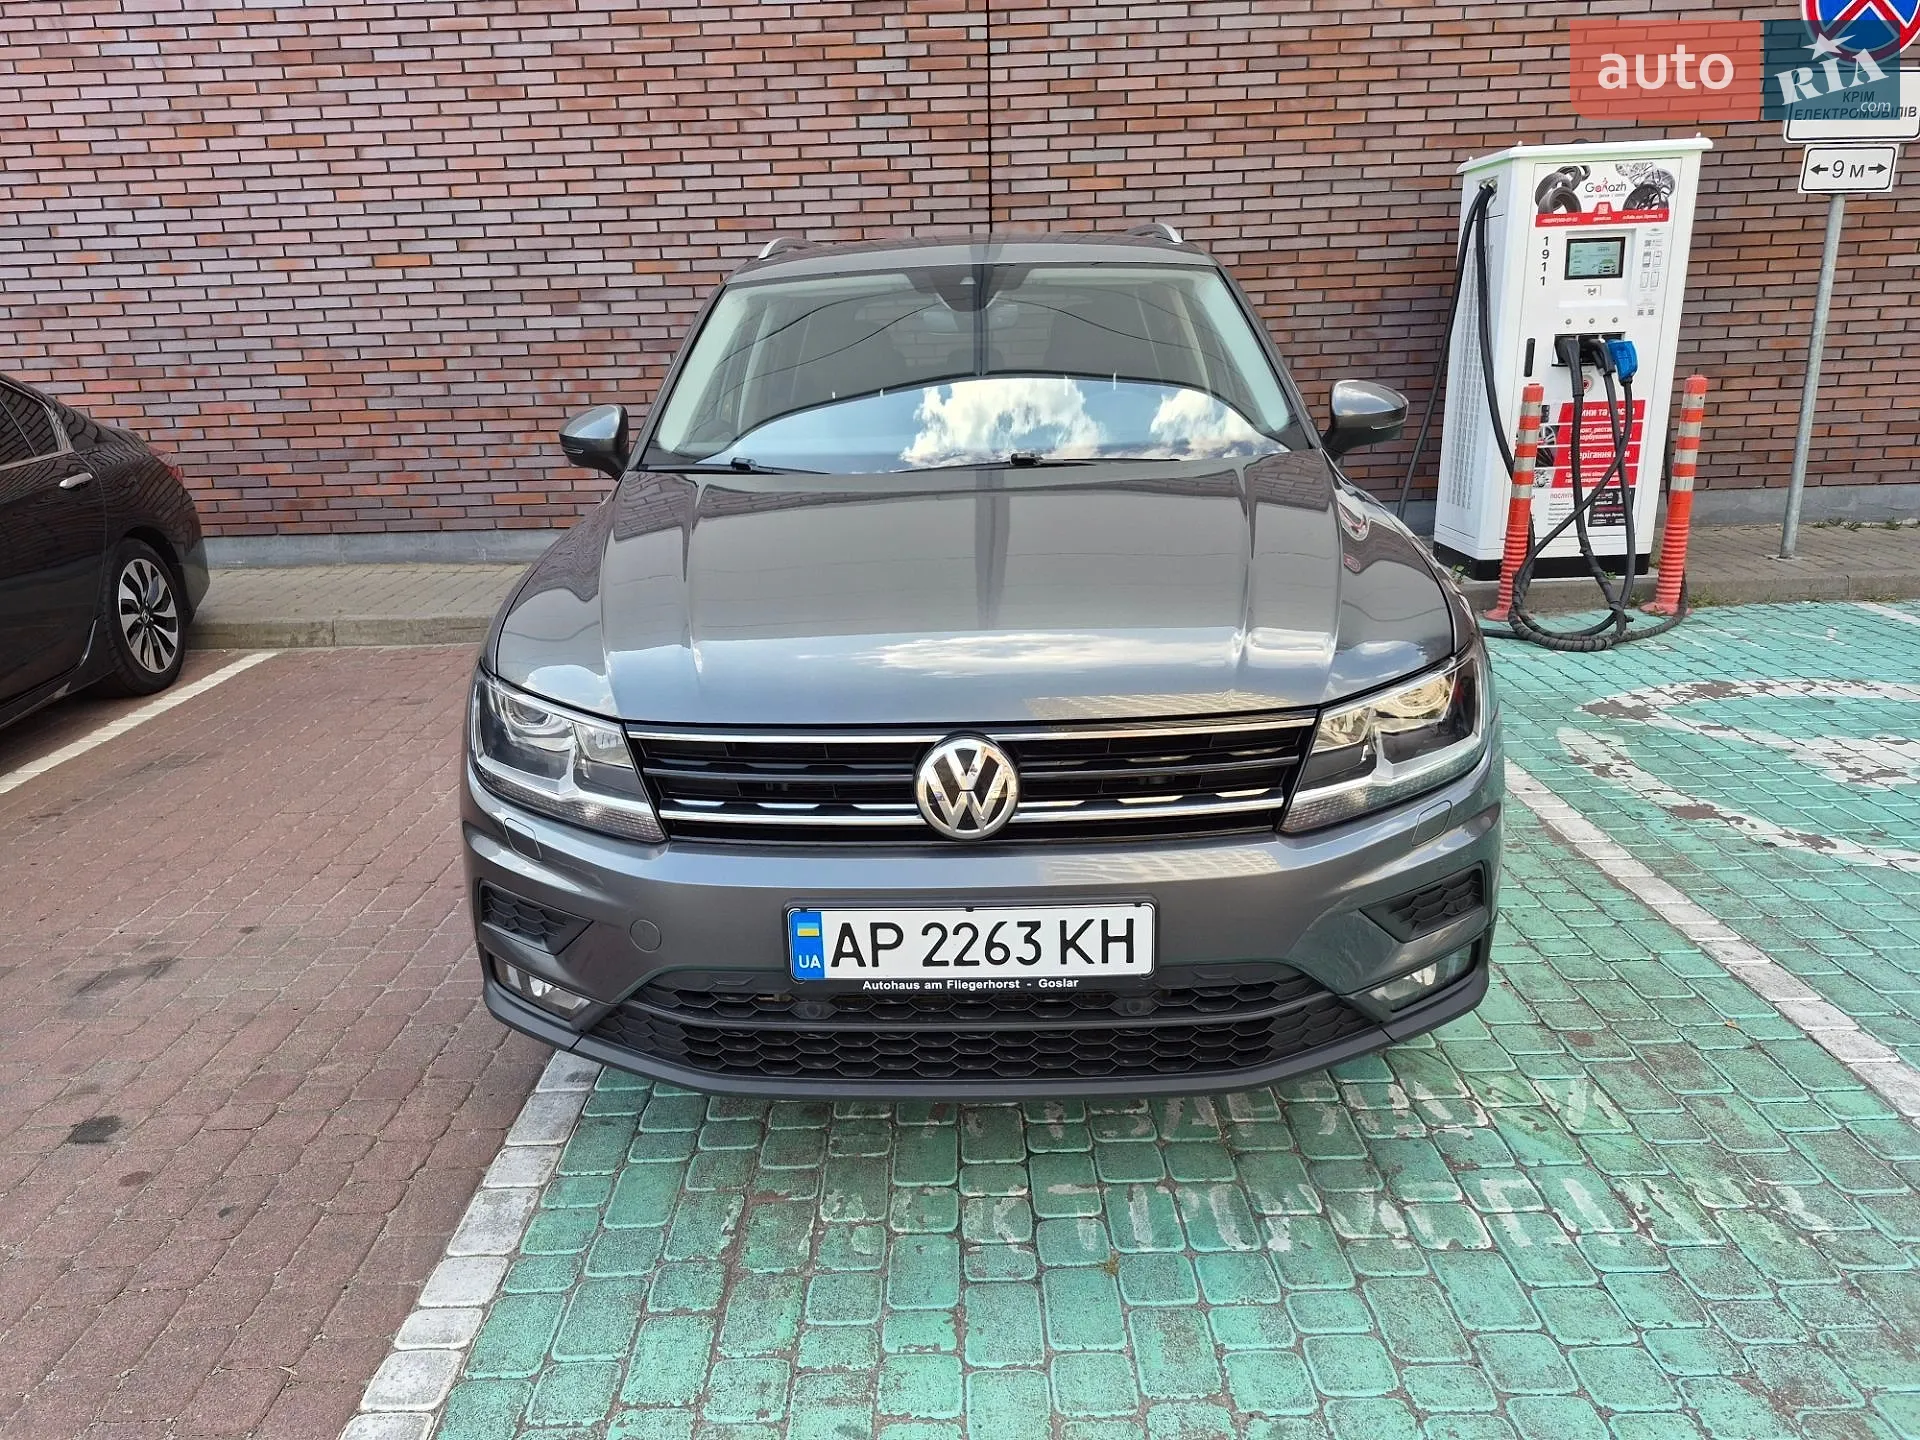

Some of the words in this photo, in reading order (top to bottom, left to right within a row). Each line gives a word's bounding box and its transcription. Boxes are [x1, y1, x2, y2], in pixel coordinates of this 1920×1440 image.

[1842, 91, 1875, 102] КРІМ
[1794, 106, 1918, 120] ЕЛЕКТРОМОБІЛІВ
[1832, 160, 1845, 178] 9
[830, 921, 904, 968] AP
[921, 920, 1042, 967] 2263
[1058, 918, 1135, 965] KH
[798, 954, 822, 969] UA
[862, 979, 920, 991] Autohaus
[924, 982, 943, 990] am
[946, 979, 1020, 992] Fliegerhorst
[1038, 978, 1079, 989] Goslar
